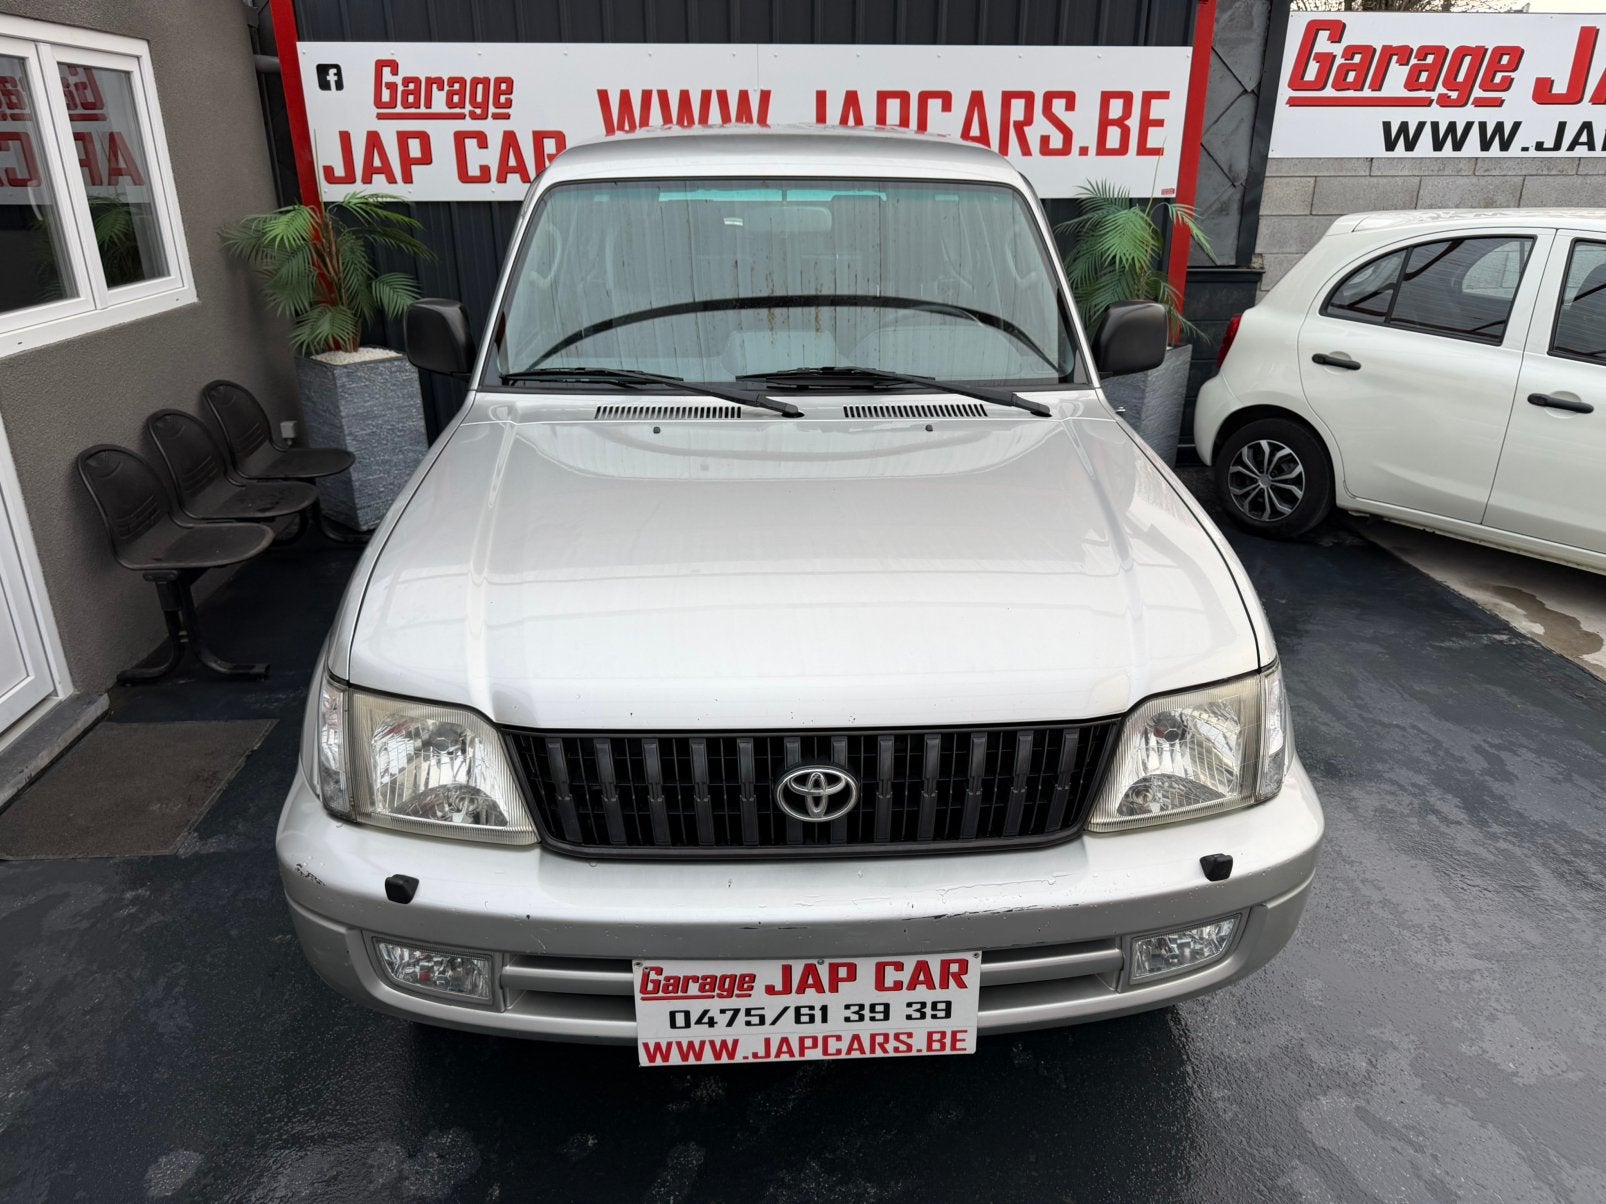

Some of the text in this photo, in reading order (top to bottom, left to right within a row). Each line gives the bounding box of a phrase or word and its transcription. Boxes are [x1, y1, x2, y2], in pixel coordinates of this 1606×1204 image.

[1287, 19, 1606, 108] Garage J
[373, 59, 514, 120] Garage
[1381, 120, 1606, 152] WWW.JA
[322, 130, 567, 185] JAP CAR
[639, 958, 969, 999] Garage JAP CAR
[668, 1000, 952, 1030] 0475/61 39 39
[642, 1030, 968, 1064] WWW.JAPCARS.BE
